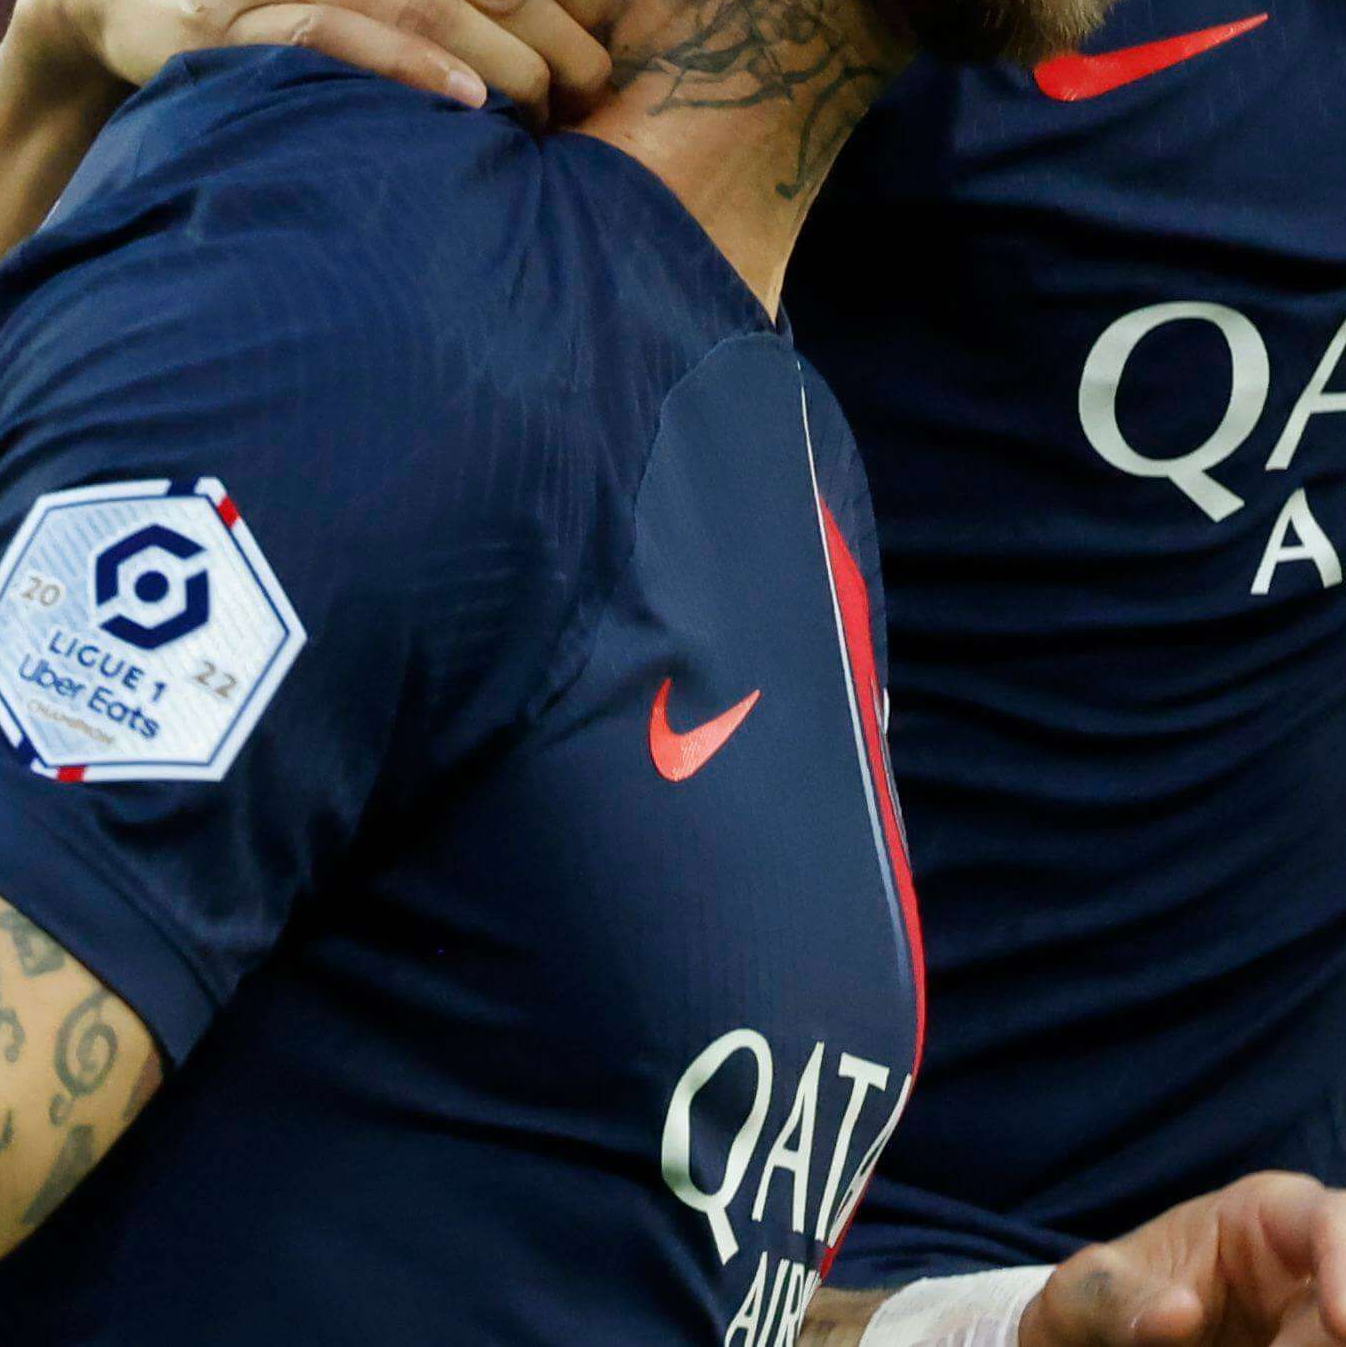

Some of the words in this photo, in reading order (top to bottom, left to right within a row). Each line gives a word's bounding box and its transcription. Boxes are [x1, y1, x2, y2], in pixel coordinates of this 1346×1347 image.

[19, 575, 62, 607] 20
[18, 653, 87, 700] Uber
[86, 685, 161, 740] Eats
[48, 628, 148, 691] LIGUE
[152, 680, 168, 704] 1
[193, 659, 239, 699] 22
[661, 1028, 913, 1267] QATA
